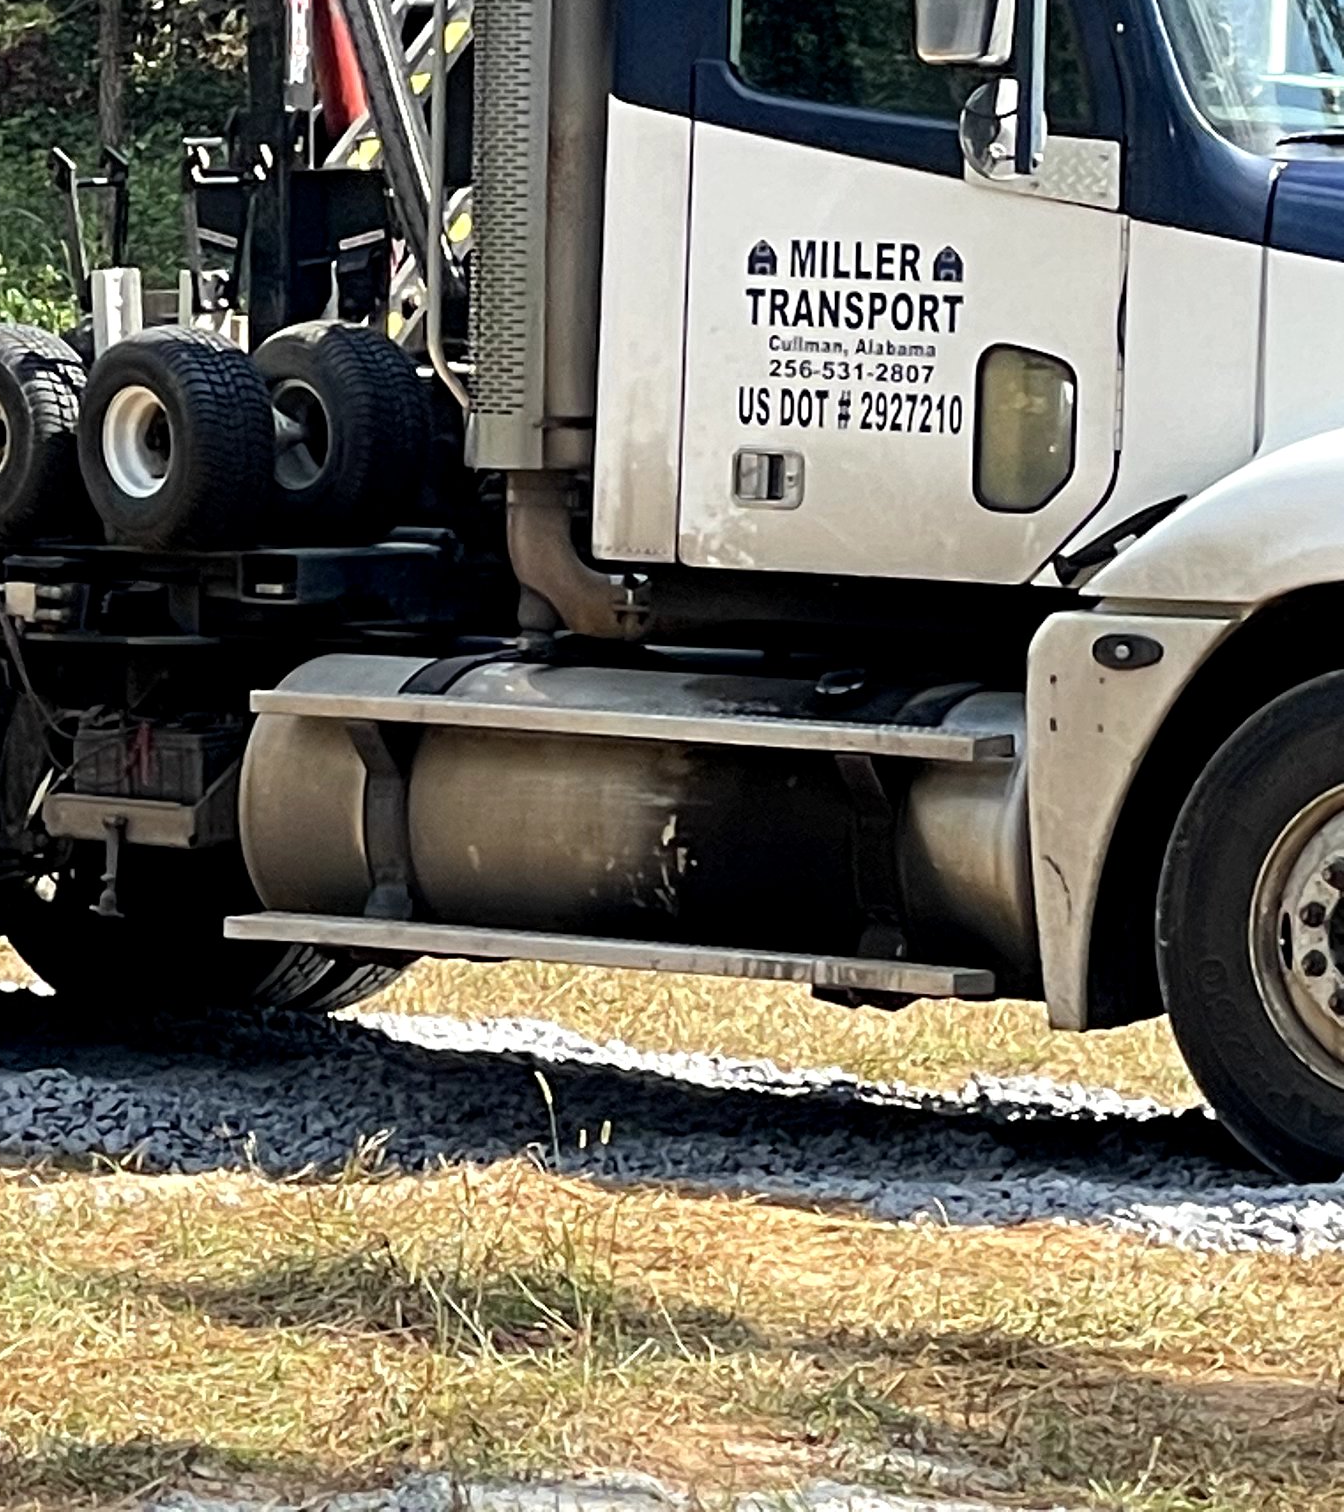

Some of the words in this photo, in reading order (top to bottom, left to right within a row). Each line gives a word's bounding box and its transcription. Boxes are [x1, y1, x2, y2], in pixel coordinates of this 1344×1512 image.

[790, 239, 921, 282] MILLER
[745, 288, 964, 333] TRANSPORT
[768, 334, 849, 357] Cullman,
[855, 338, 937, 358] Alabama
[768, 359, 935, 384] 256-531-2807
[738, 386, 770, 426] US
[779, 387, 829, 429] DOT
[837, 389, 852, 430] #
[859, 391, 963, 435] 2927210
